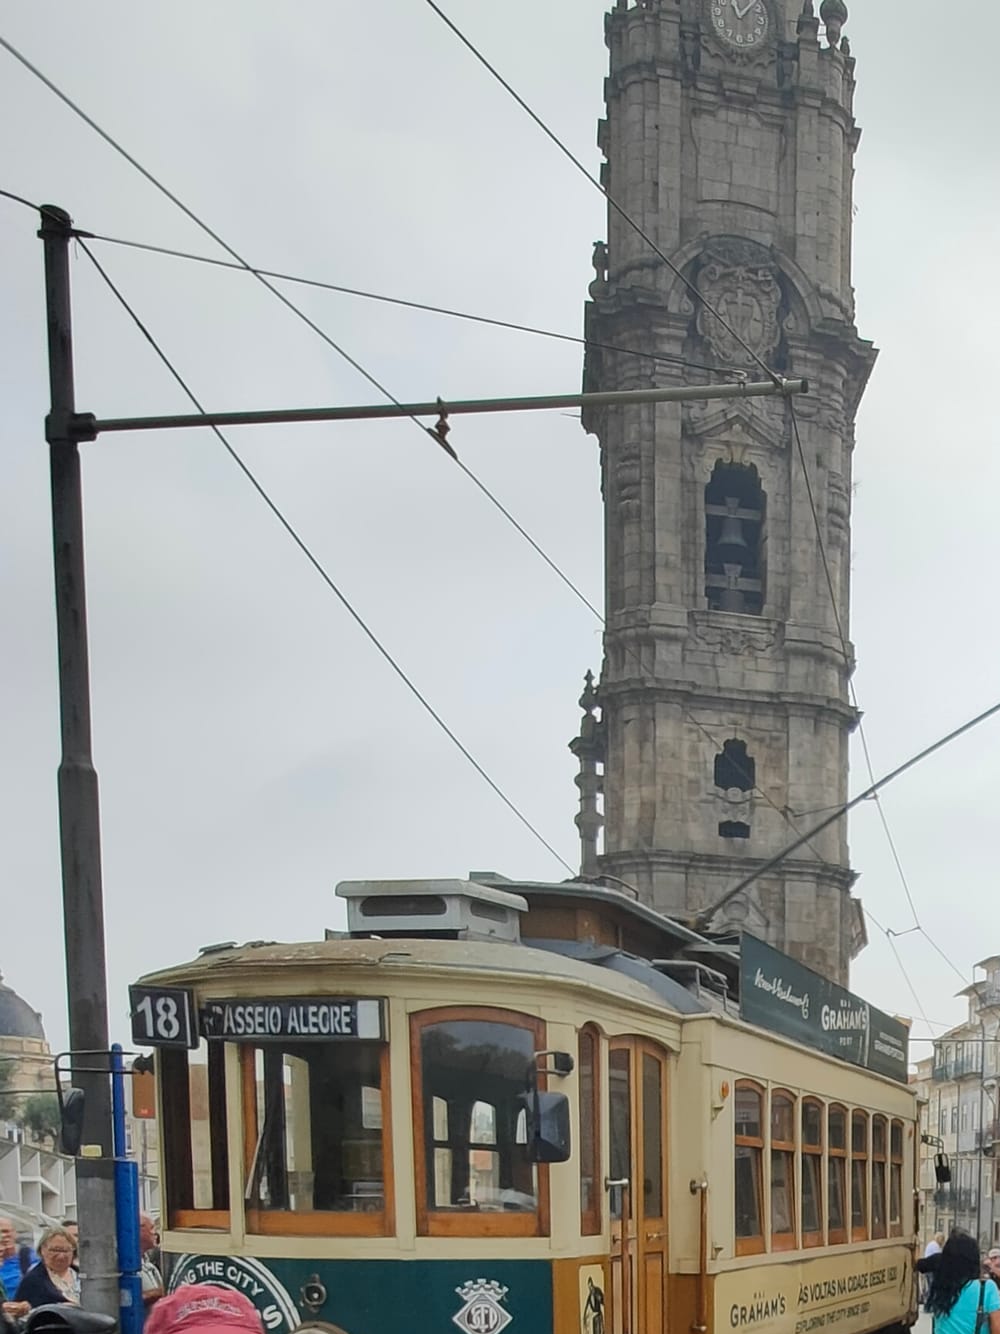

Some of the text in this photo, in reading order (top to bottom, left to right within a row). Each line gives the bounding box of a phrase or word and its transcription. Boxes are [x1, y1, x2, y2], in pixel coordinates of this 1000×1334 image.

[136, 996, 180, 1039] 18
[286, 1005, 352, 1034] ALEGRE
[196, 1261, 225, 1277] THE
[226, 1266, 265, 1296] CITY
[730, 1293, 786, 1328] GRAHAM'S
